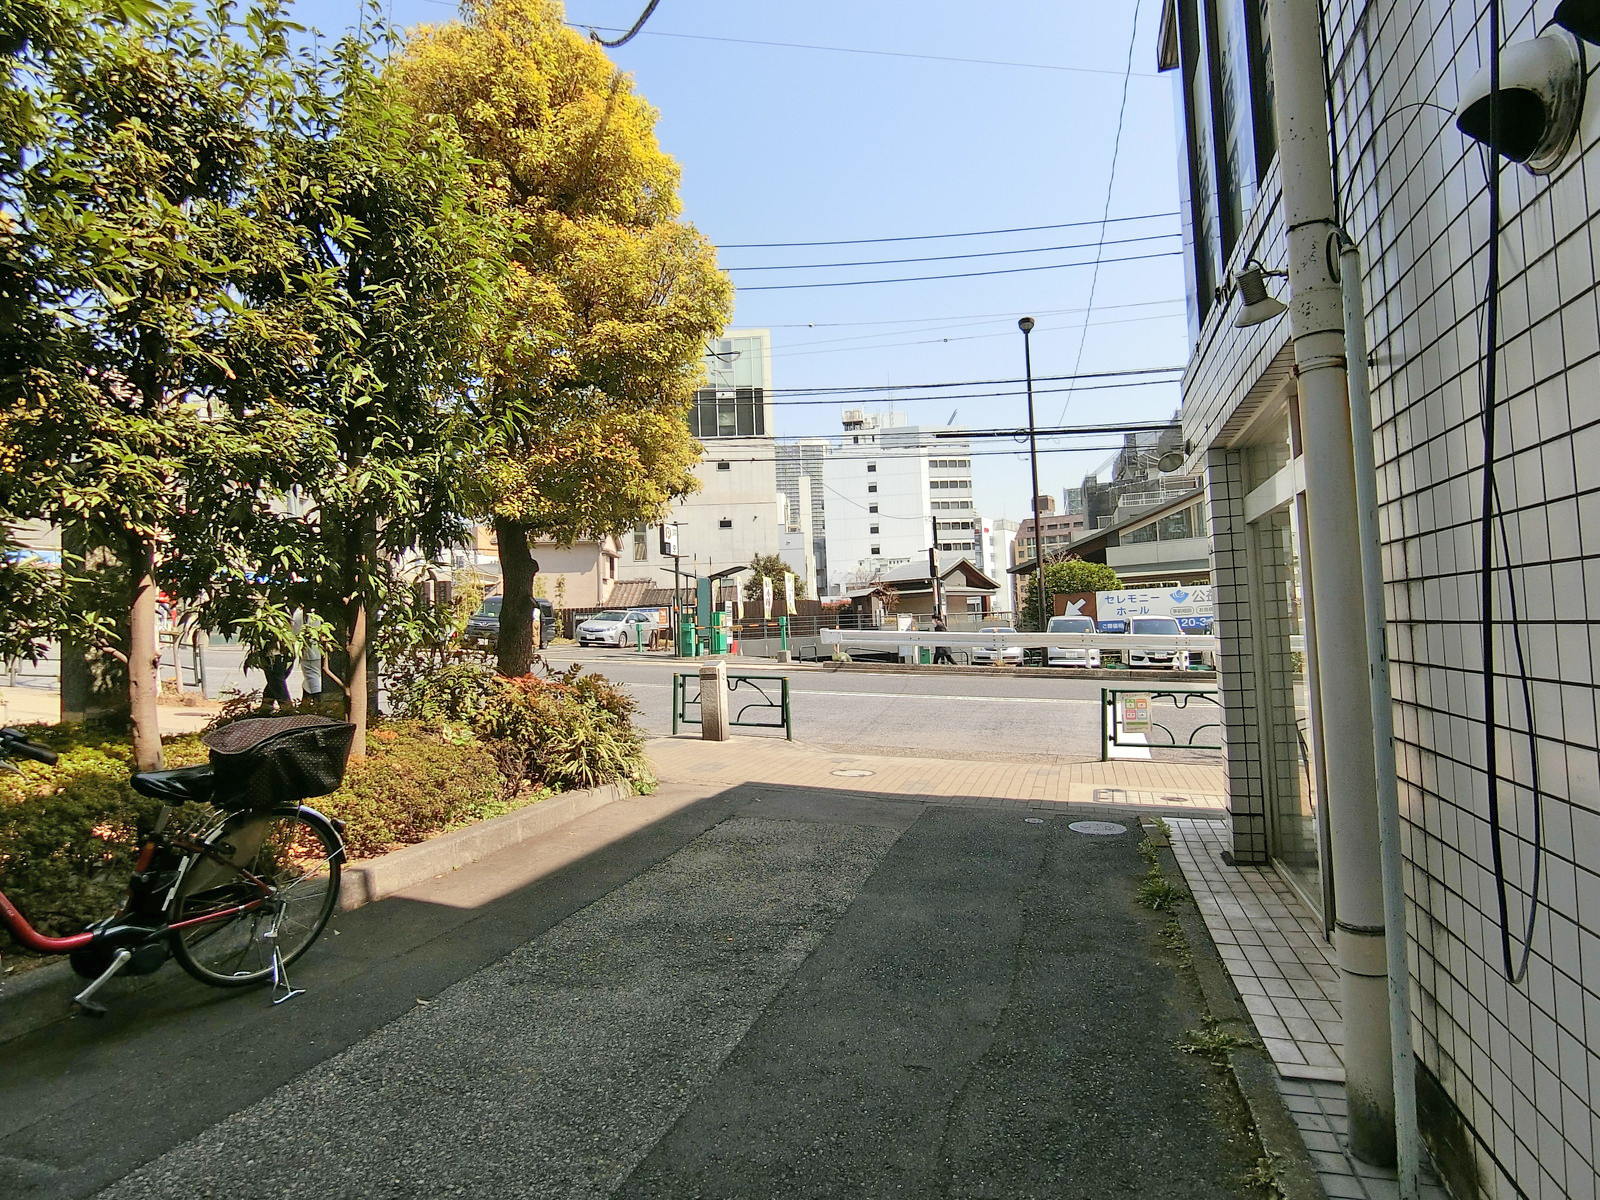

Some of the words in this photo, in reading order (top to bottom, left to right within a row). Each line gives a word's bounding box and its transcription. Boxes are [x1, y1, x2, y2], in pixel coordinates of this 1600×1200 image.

[1104, 594, 1160, 605] セレモニー
[1116, 606, 1150, 616] ホール
